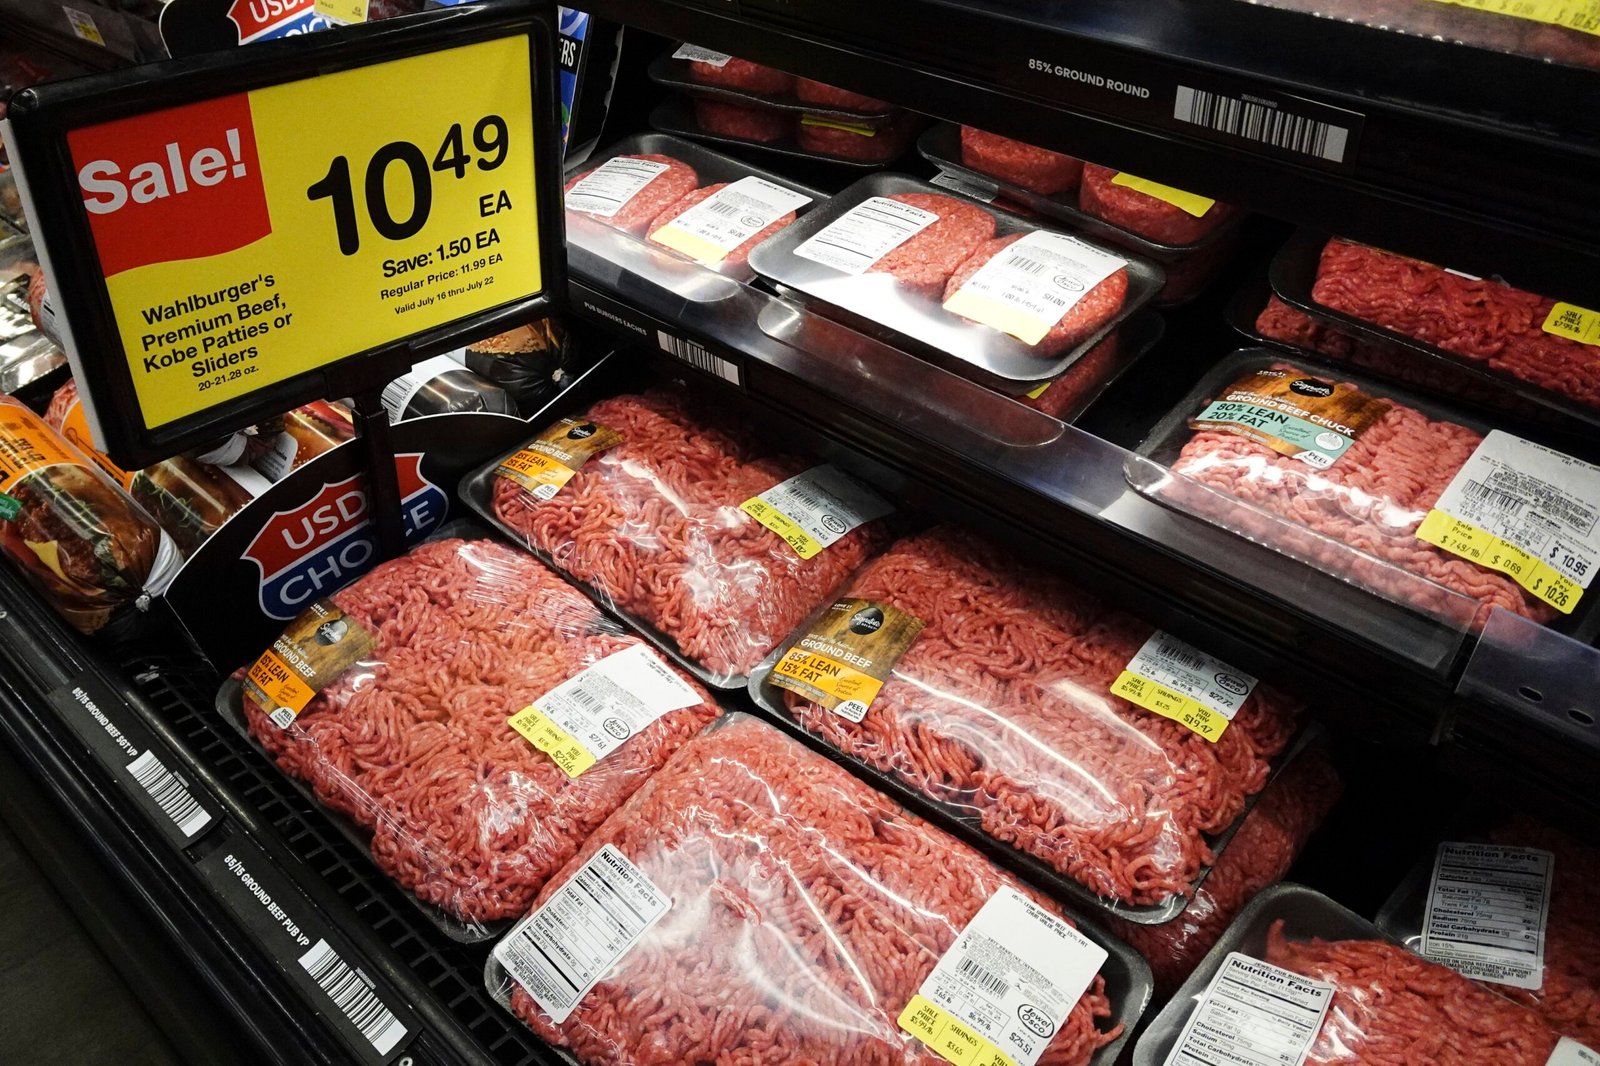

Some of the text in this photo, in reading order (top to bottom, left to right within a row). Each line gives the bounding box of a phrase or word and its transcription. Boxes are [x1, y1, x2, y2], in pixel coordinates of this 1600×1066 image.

[560, 38, 576, 67] RS
[1028, 58, 1150, 99] 85% GROUND ROUND
[78, 128, 247, 214] Sale!
[479, 189, 512, 217] EA
[382, 228, 500, 277] Save: 1.50 EA
[380, 253, 503, 300] Regular Price: 11.99 EA
[141, 274, 275, 325] Wahlburger's
[394, 276, 494, 315] Valid July 16 thru July 22
[141, 293, 286, 352] Premium Beef,
[143, 313, 293, 374] Kobe Patties or
[191, 346, 258, 378] Sliders
[198, 365, 259, 392] 20-21.28 oz.
[1207, 411, 1269, 428] 20% FAT
[1216, 403, 1289, 425] 80% LEAN
[1226, 394, 1278, 408] GROUND
[1278, 402, 1310, 418] BEEF
[1309, 414, 1356, 437] CHUCK
[527, 454, 548, 467] LEAN
[552, 450, 573, 462] BEEF
[1308, 451, 1328, 464] PEEL
[518, 462, 532, 473] FAT
[281, 490, 368, 549] USD
[1440, 535, 1448, 544] $
[1451, 526, 1473, 541] Price
[1456, 520, 1531, 561] Sale Savings
[280, 500, 435, 605] CHOE
[1550, 546, 1589, 577] $ 10.95
[1491, 554, 1522, 575] $ 0.69
[1532, 577, 1569, 607] $ 10.26
[1553, 579, 1570, 593] Pay
[1559, 574, 1574, 588] You
[273, 639, 300, 664] GROUND
[295, 659, 317, 679] BEEF
[788, 652, 841, 677] 85% LEAN
[800, 638, 844, 658] GROUND
[844, 652, 872, 669] BEEF
[259, 672, 274, 687] FAT
[267, 661, 290, 683] LEAN
[780, 661, 822, 683] 15% FAT
[1219, 673, 1245, 689] Jewel
[1218, 677, 1241, 693] Osco
[847, 701, 864, 714] PEEL
[1157, 689, 1183, 704] SAVINGS
[72, 687, 138, 757] 85/15 GROUND BEEF SGT VP
[281, 708, 293, 720] PEEL
[605, 722, 622, 736] Osco
[609, 719, 628, 733] Jewel
[1444, 847, 1539, 862] Nutrition Facts
[577, 875, 594, 893] Calories
[601, 851, 657, 907] Nutrition Facts
[224, 854, 310, 947] 85/15 GROUND BEEF PUB VP
[565, 887, 584, 907] Total Fat
[539, 913, 554, 929] Sodium
[545, 906, 569, 930] Cholesterol
[1433, 908, 1474, 917] Cholesterol
[527, 926, 541, 941] Protein
[533, 919, 572, 960] Total Carbohydrate
[1450, 924, 1500, 935] Carbohydrate
[1231, 959, 1321, 997] Nutrition Facts
[1254, 962, 1313, 986] JEWEL PUB BURGER
[1508, 968, 1532, 976] AMOUNT
[1216, 986, 1243, 1000] Calories
[916, 1010, 937, 1027] PRICE
[922, 1005, 939, 1019] SALE
[1023, 1007, 1052, 1029] Jewel
[1209, 1000, 1239, 1015] Total Fat
[1021, 1013, 1046, 1034] Osco
[1196, 1021, 1236, 1040] Cholesterol
[949, 1024, 979, 1047] SAVINGS
[1009, 1031, 1033, 1056] $25.51
[1192, 1028, 1218, 1043] Sodium
[1184, 1043, 1209, 1058] Protein
[1188, 1036, 1254, 1066] Total Carbohydrate
